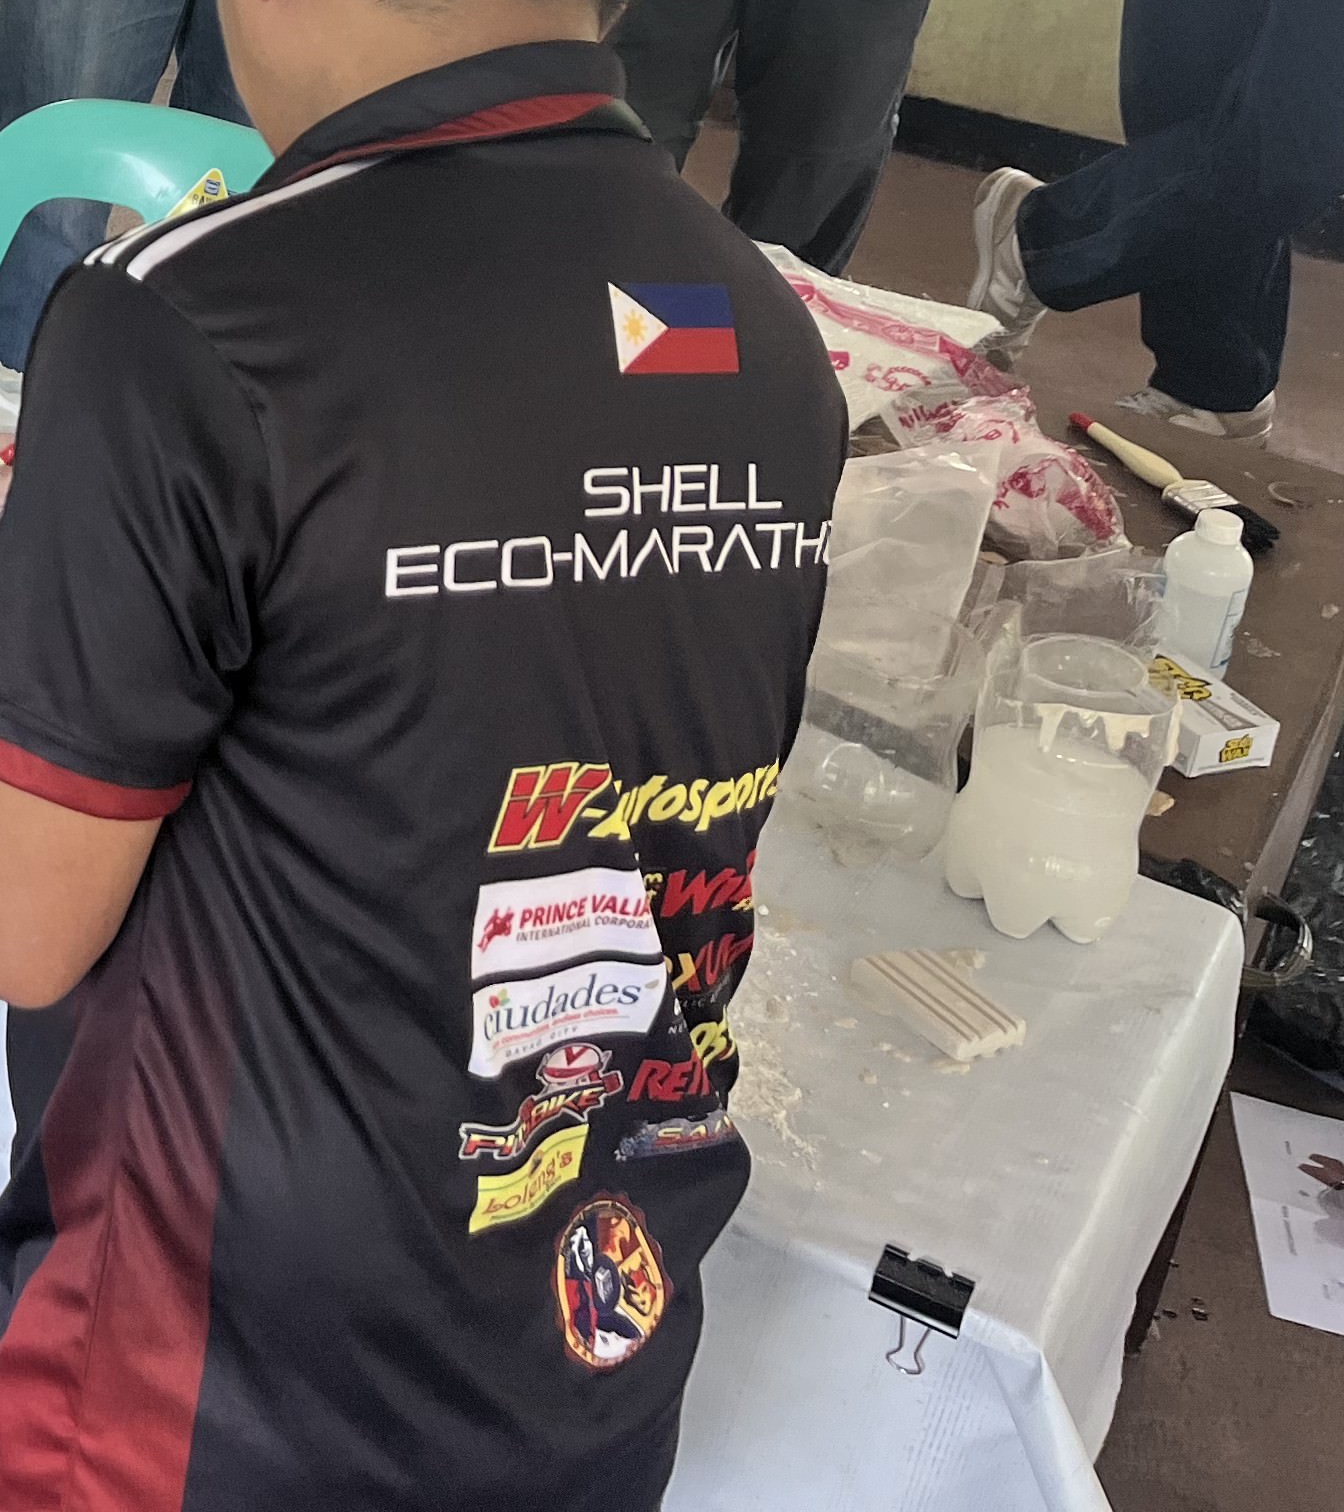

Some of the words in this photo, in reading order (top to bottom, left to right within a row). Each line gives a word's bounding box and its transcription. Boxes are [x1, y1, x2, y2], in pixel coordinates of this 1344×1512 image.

[583, 462, 783, 518] SHELL
[385, 519, 833, 598] ECO-MARATH
[516, 917, 591, 942] INTERNATIONAL
[519, 896, 588, 929] PRINCE
